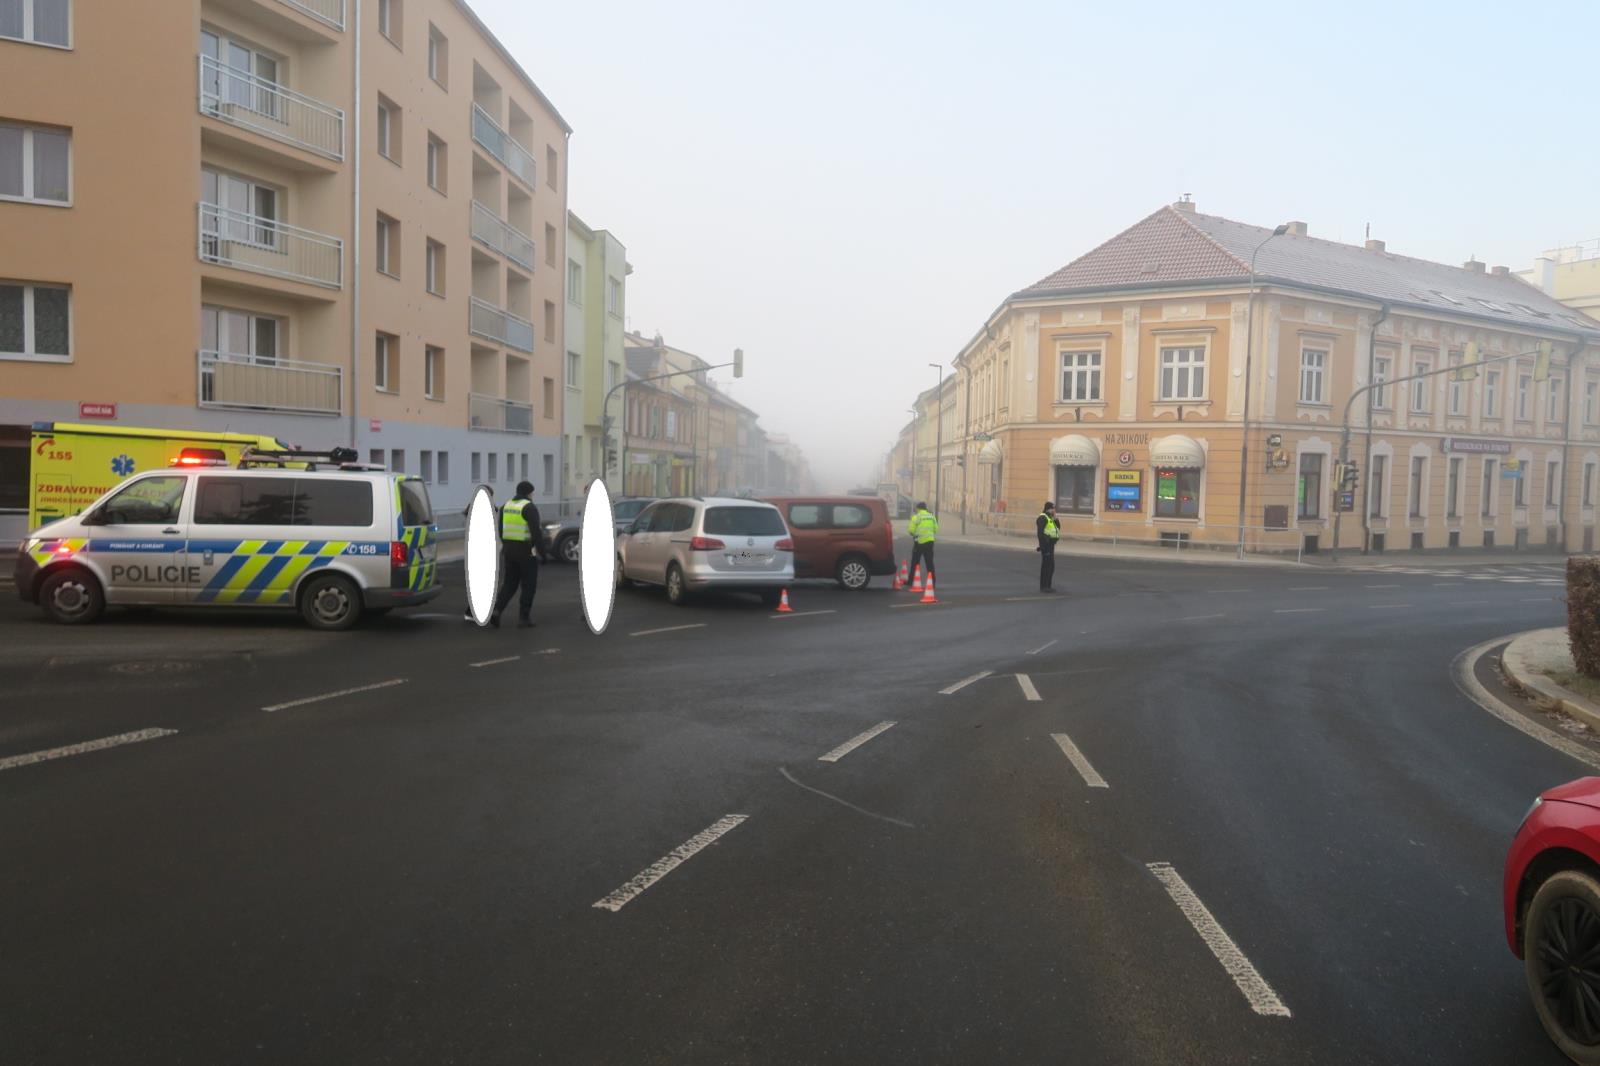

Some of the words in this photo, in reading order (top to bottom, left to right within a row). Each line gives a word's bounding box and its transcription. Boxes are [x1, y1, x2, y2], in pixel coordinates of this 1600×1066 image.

[48, 451, 72, 460] 155
[359, 544, 377, 554] 158
[111, 565, 201, 583] POLICIE
